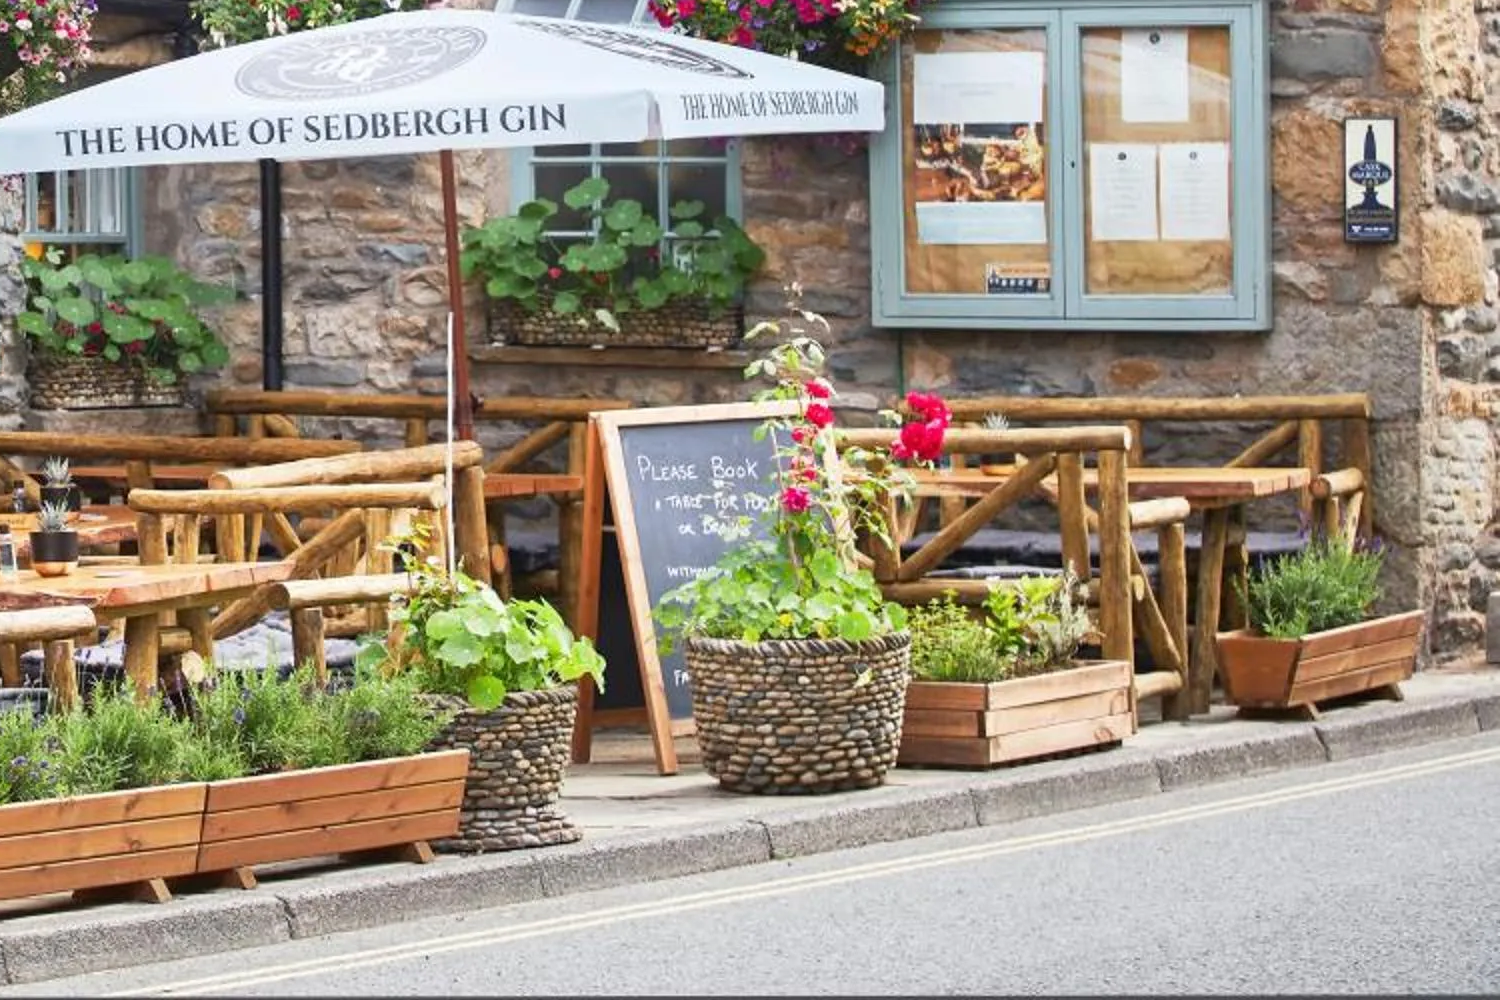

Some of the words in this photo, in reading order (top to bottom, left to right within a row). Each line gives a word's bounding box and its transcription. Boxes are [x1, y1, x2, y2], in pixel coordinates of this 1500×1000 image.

[680, 95, 708, 121] THE
[710, 92, 750, 119] HOME
[750, 91, 767, 117] OF
[770, 90, 833, 116] SEDBERGH
[835, 90, 859, 115] GIN
[56, 127, 127, 157] THE
[136, 120, 239, 152] HOME
[248, 117, 293, 145] OF
[304, 107, 488, 142] SEDBERGH
[500, 103, 567, 133] GIN
